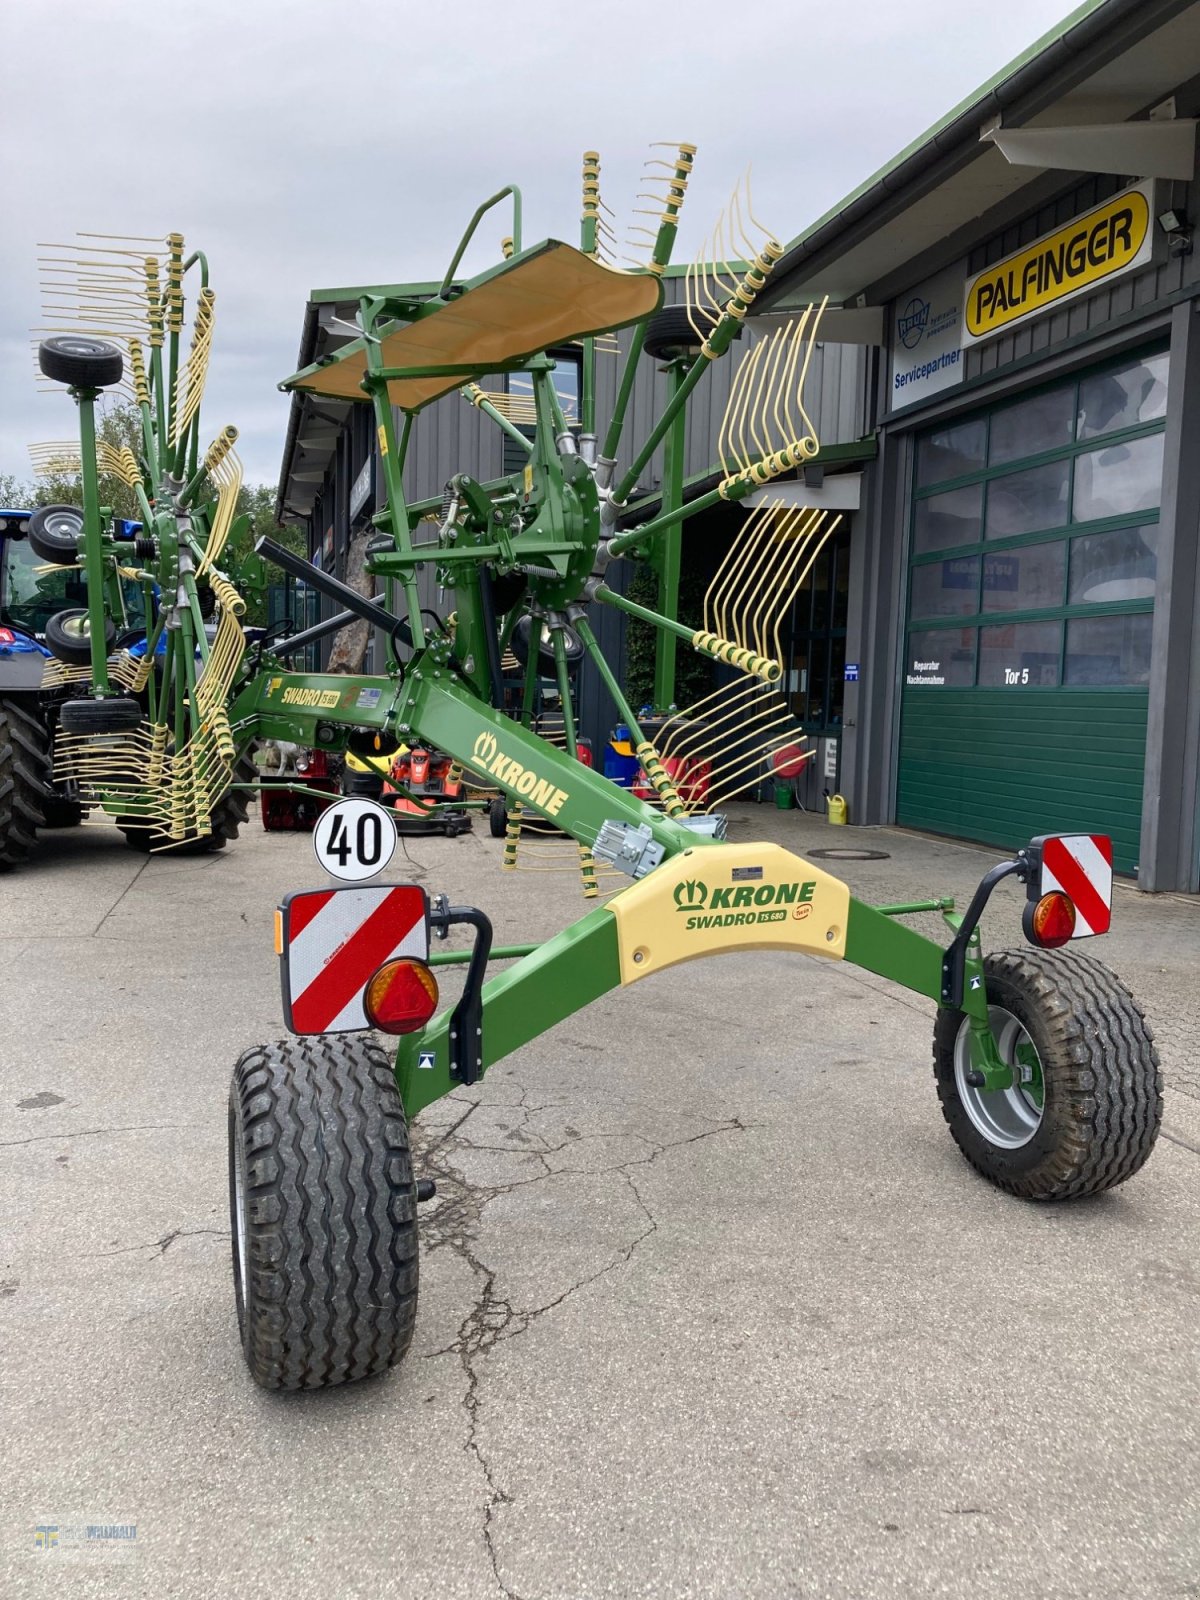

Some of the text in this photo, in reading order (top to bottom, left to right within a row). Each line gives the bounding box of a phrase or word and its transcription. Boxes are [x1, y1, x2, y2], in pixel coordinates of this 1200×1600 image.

[976, 208, 1133, 325] PALFINGER
[895, 349, 961, 390] Servicepartner
[914, 661, 940, 672] Reparatur
[1005, 668, 1029, 685] Tor 5
[907, 675, 945, 685] Nachtannahme
[281, 687, 321, 707] SWADRO
[488, 752, 569, 817] KRONE
[326, 812, 382, 867] 40
[709, 881, 817, 909] KRONE
[685, 912, 757, 930] SWADRO
[760, 914, 770, 922] TS
[770, 911, 784, 921] 680
